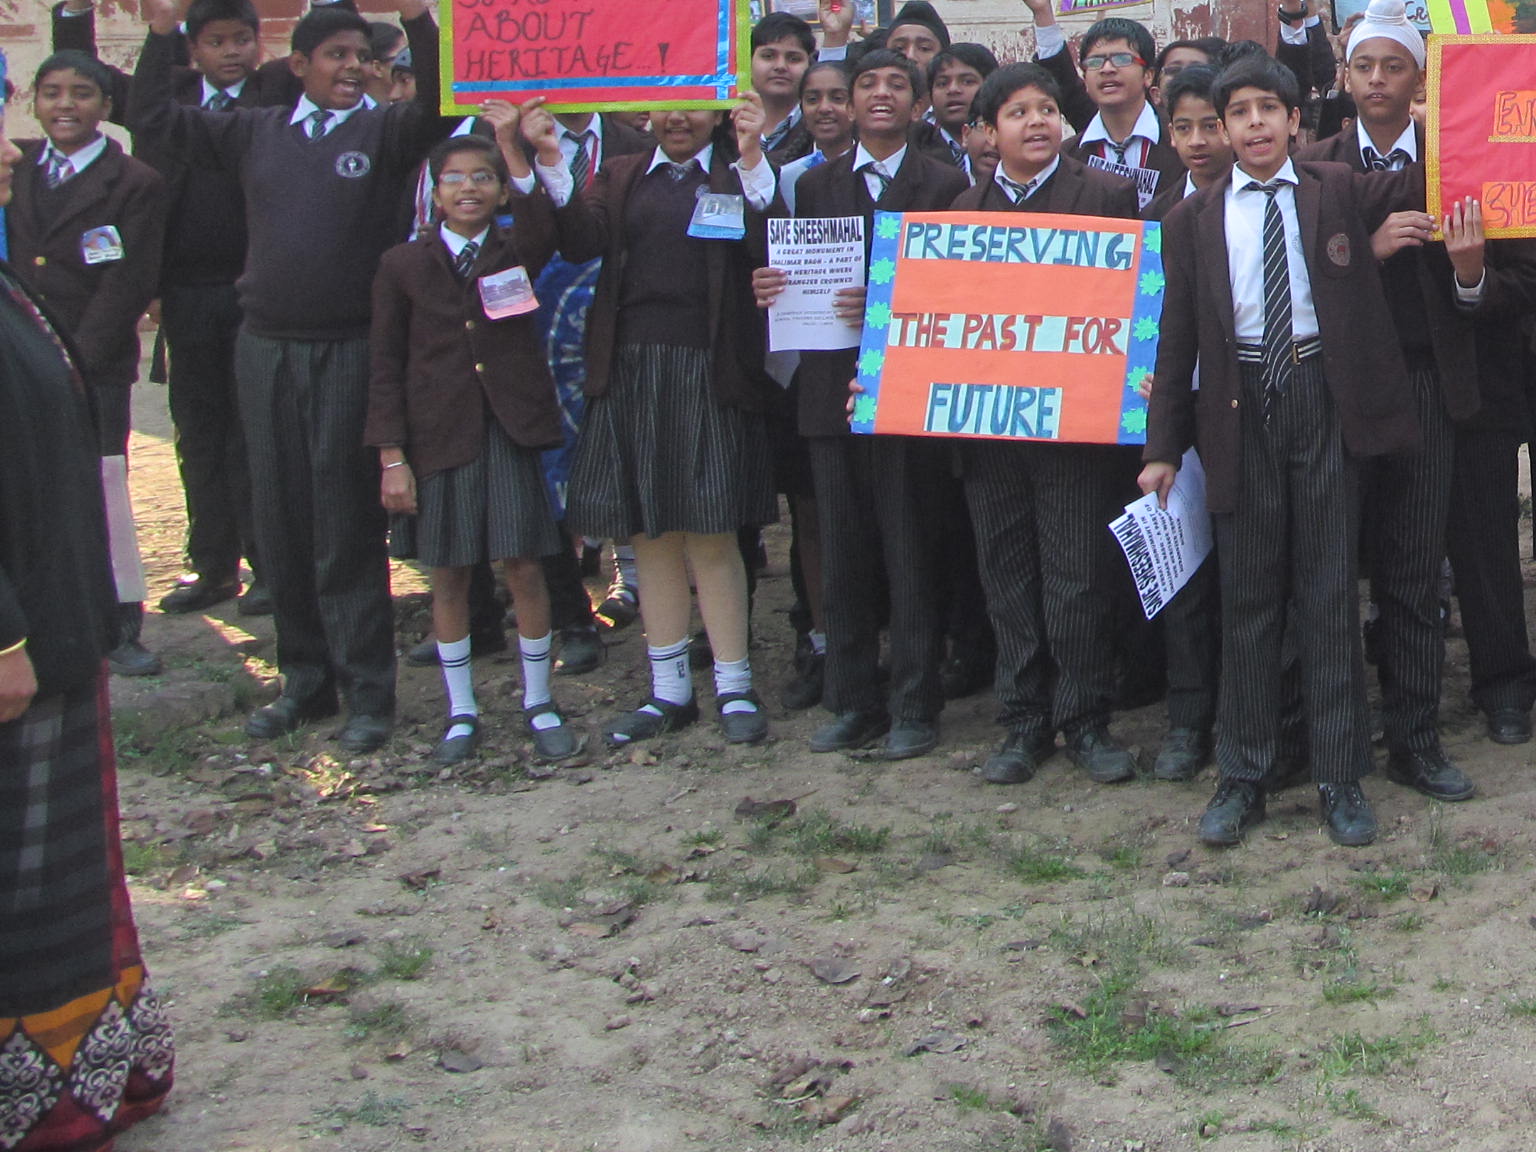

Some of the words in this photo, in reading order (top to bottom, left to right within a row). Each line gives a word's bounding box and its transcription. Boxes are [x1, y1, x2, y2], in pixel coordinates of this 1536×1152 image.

[462, 8, 595, 43] ABOUT
[770, 219, 792, 245] SAVE
[793, 217, 863, 245] SHEESHMAHAL
[904, 222, 1134, 270] PRESERVING
[891, 312, 951, 349] THE
[960, 313, 1044, 352] PAST
[1064, 316, 1127, 356] FOR
[926, 383, 1057, 438] FUTURE
[1112, 513, 1157, 589] SHEESHMAHAL
[1141, 582, 1163, 616] SAVE
